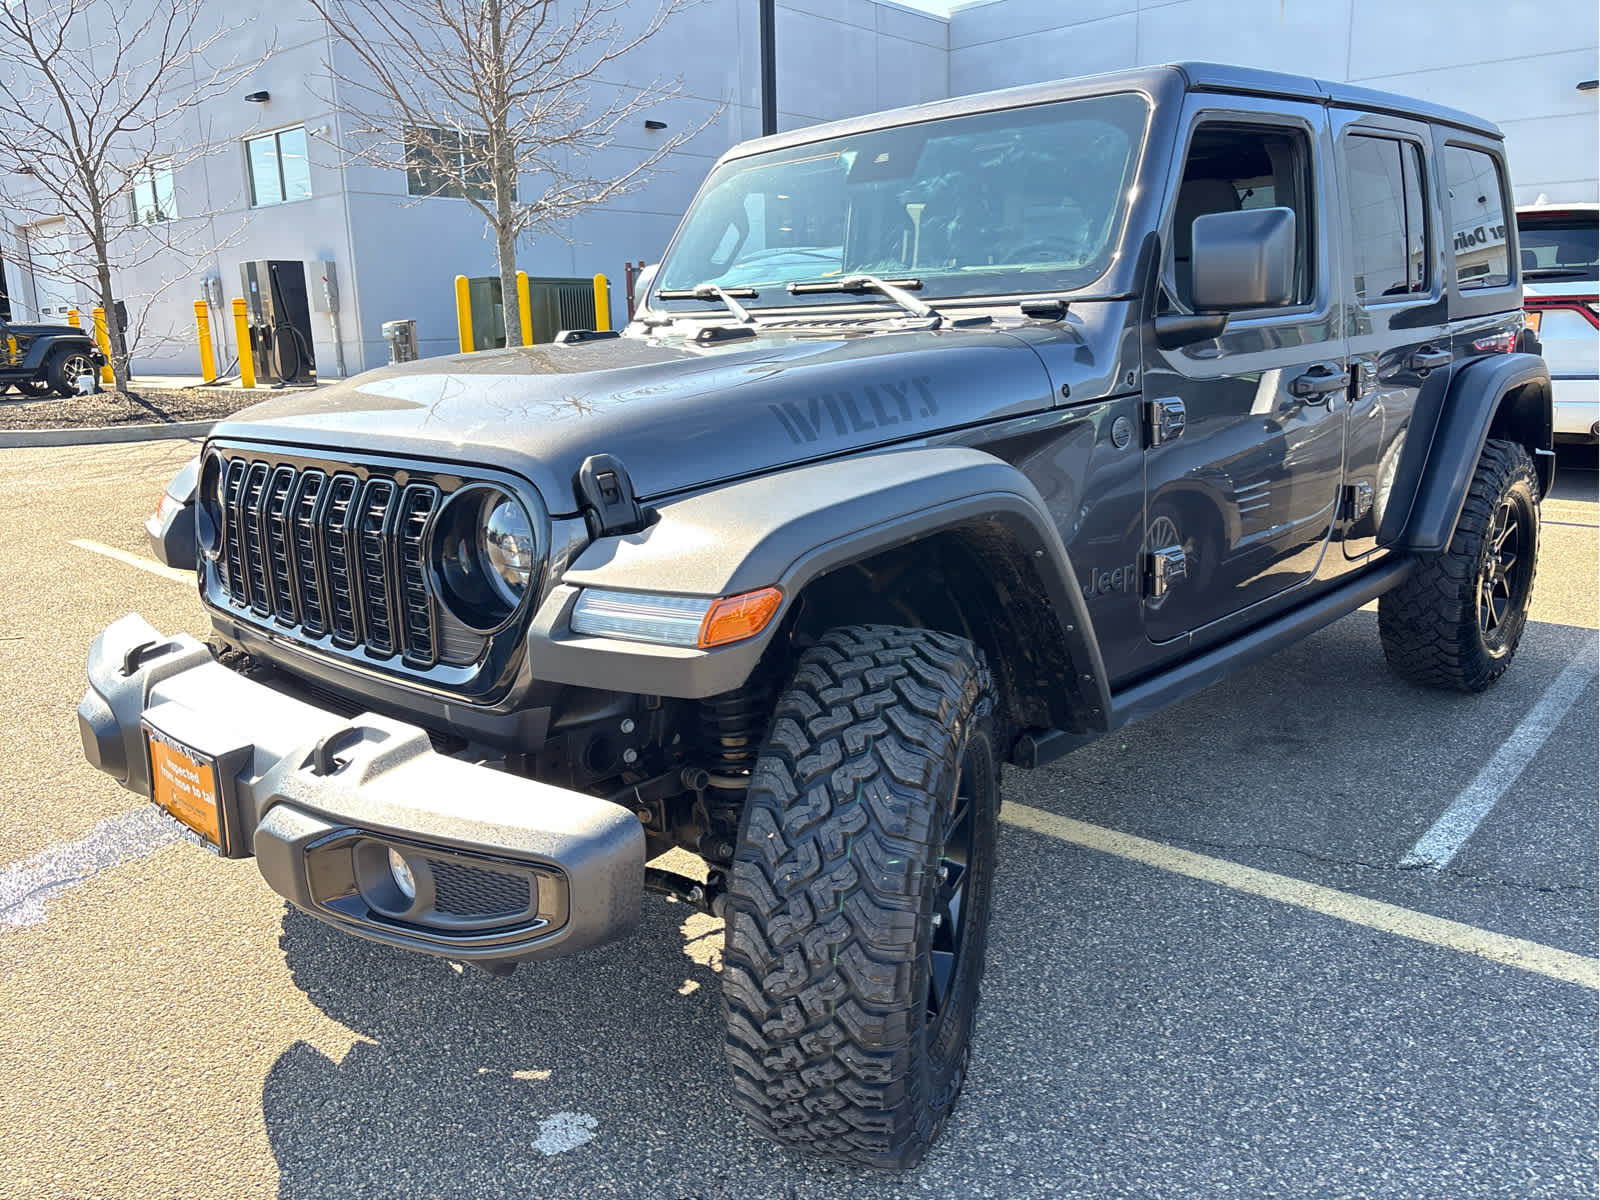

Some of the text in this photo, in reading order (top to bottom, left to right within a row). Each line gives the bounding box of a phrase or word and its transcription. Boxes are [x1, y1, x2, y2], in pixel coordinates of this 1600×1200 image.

[768, 376, 938, 444] WILLYS
[1083, 564, 1136, 598] Jeep
[192, 785, 201, 798] to
[202, 791, 216, 807] tail
